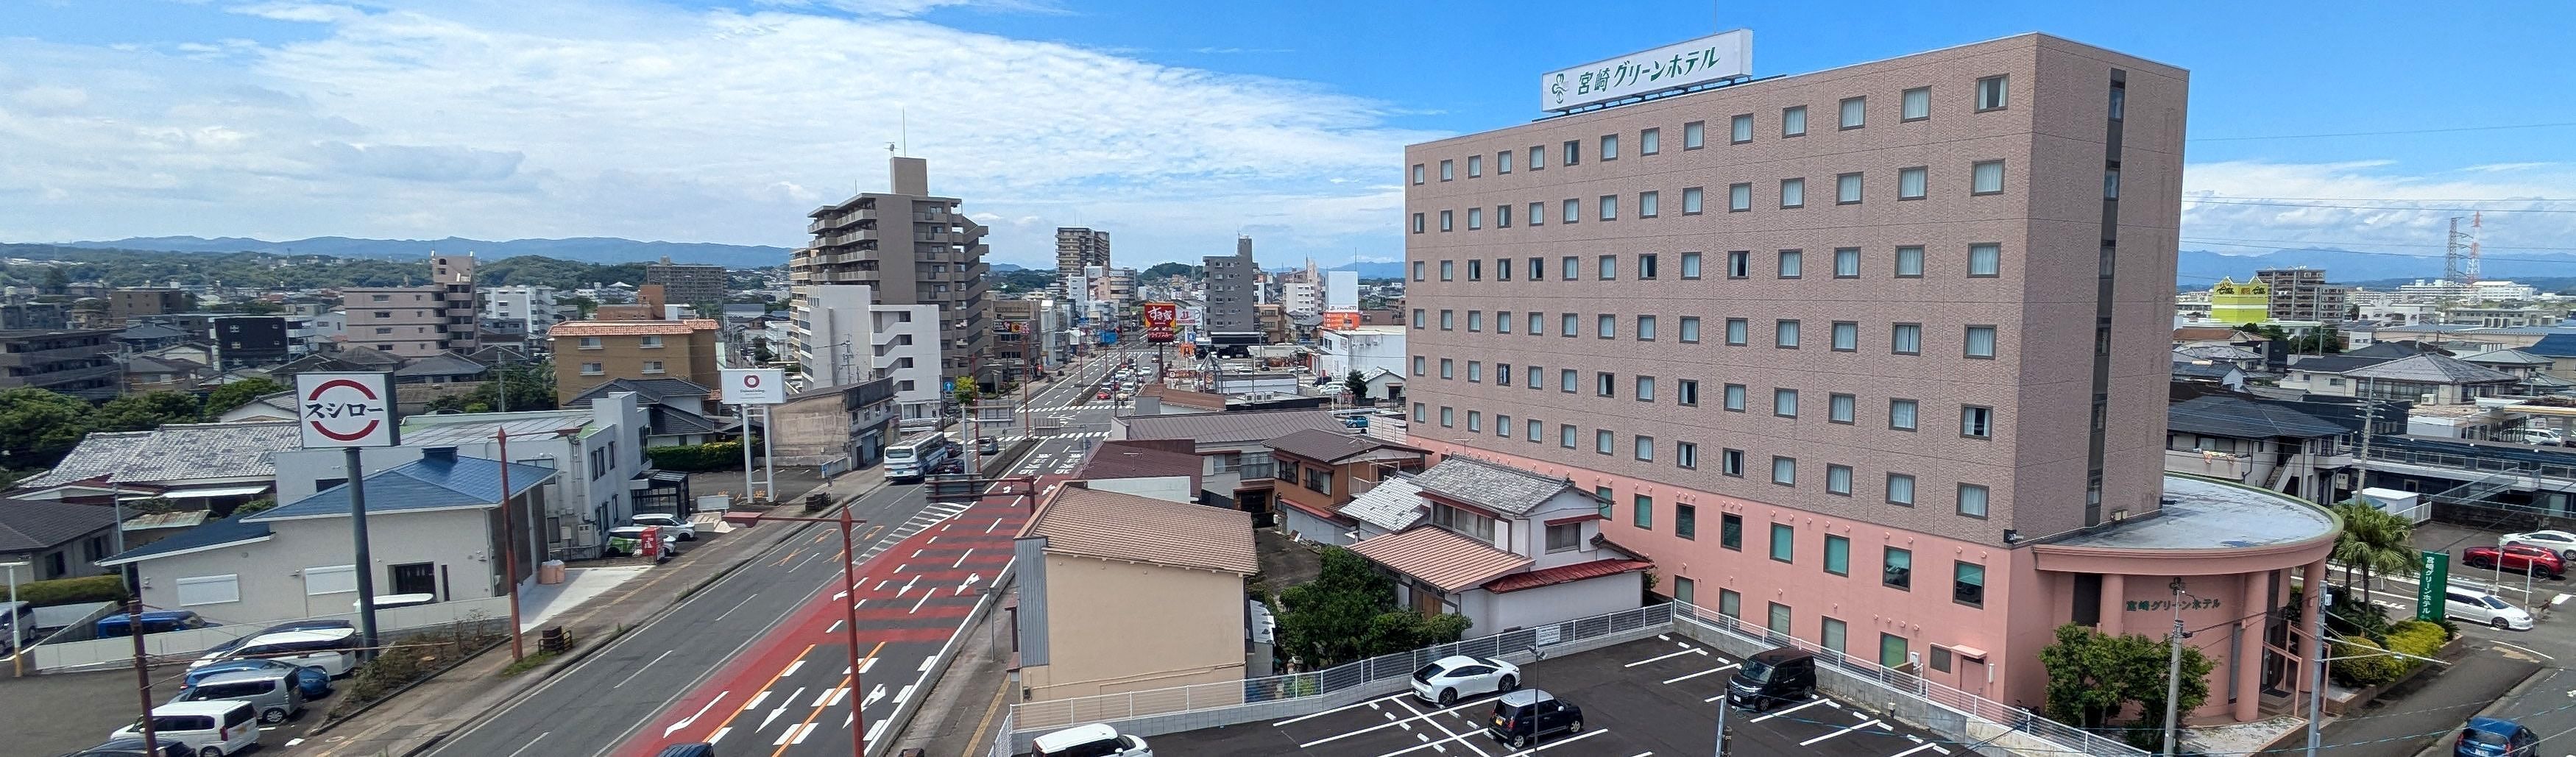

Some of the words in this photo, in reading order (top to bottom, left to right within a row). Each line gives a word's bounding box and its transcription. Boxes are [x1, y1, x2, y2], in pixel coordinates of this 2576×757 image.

[1577, 46, 1721, 96] 宮崎グリーンホテル
[1147, 306, 1172, 321] すき家
[305, 402, 384, 419] スシロー
[2422, 556, 2435, 614] 宮崎グリーンホテル
[2126, 598, 2221, 612] 宮崎グリーンホテル
